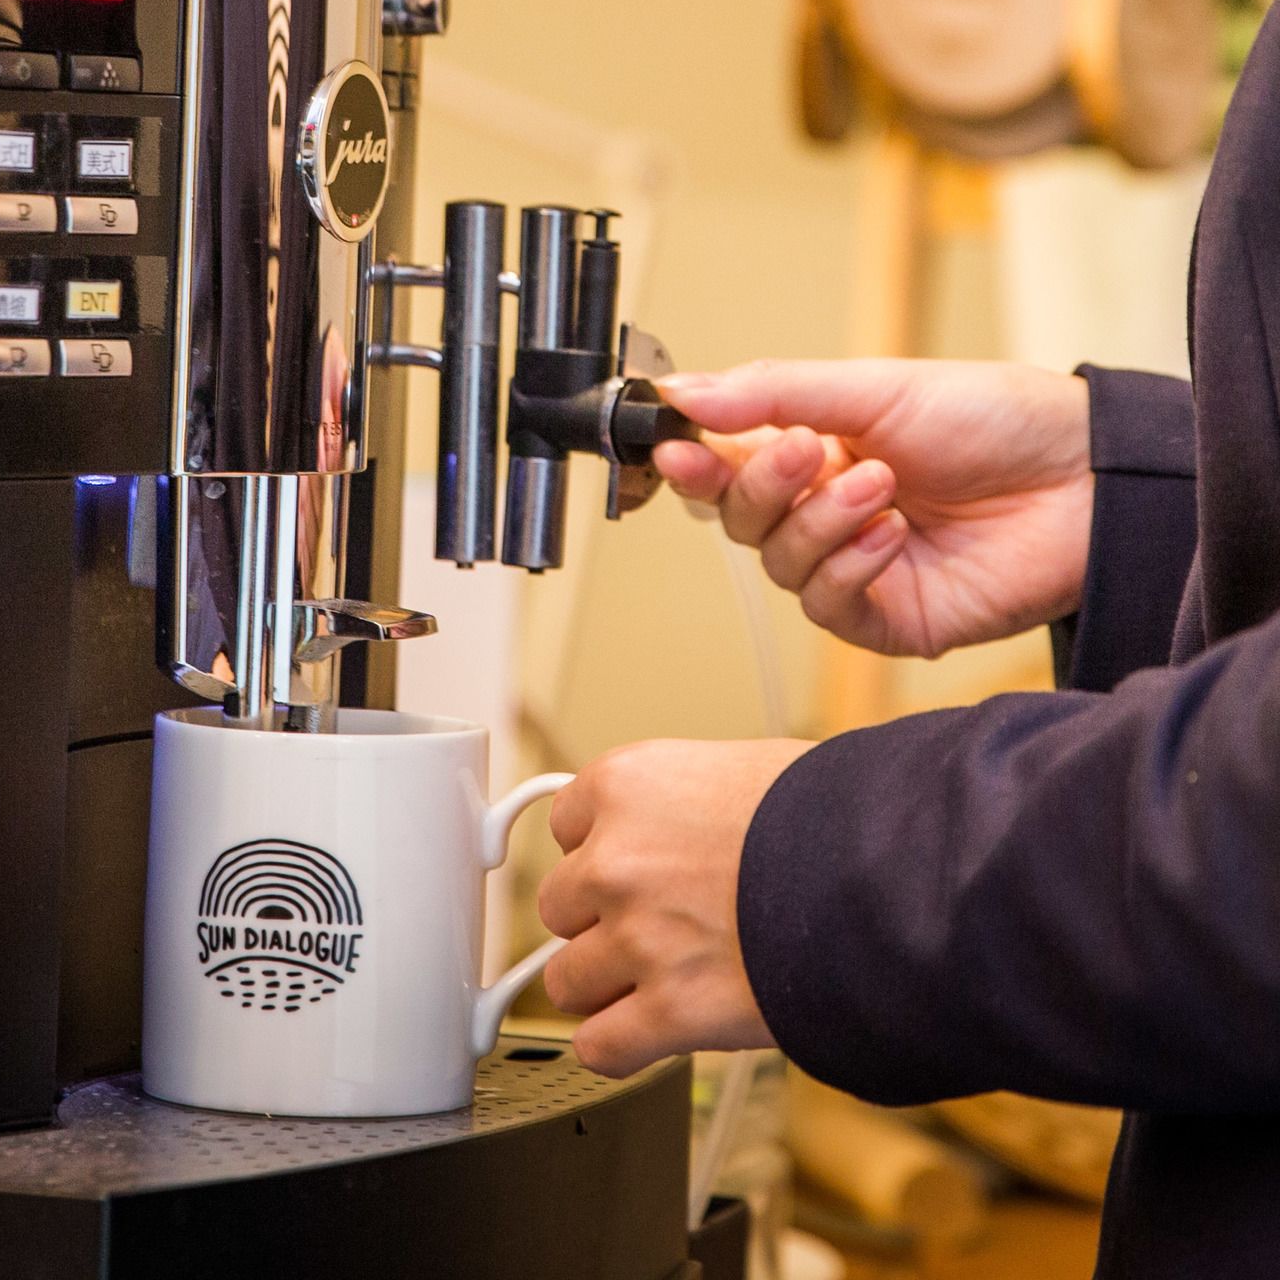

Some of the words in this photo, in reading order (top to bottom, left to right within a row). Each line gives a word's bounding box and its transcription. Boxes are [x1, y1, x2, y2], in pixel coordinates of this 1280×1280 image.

[325, 119, 388, 187] jura
[79, 291, 110, 312] ENT
[197, 921, 237, 965] SUN
[244, 927, 365, 974] DIALOGUE
